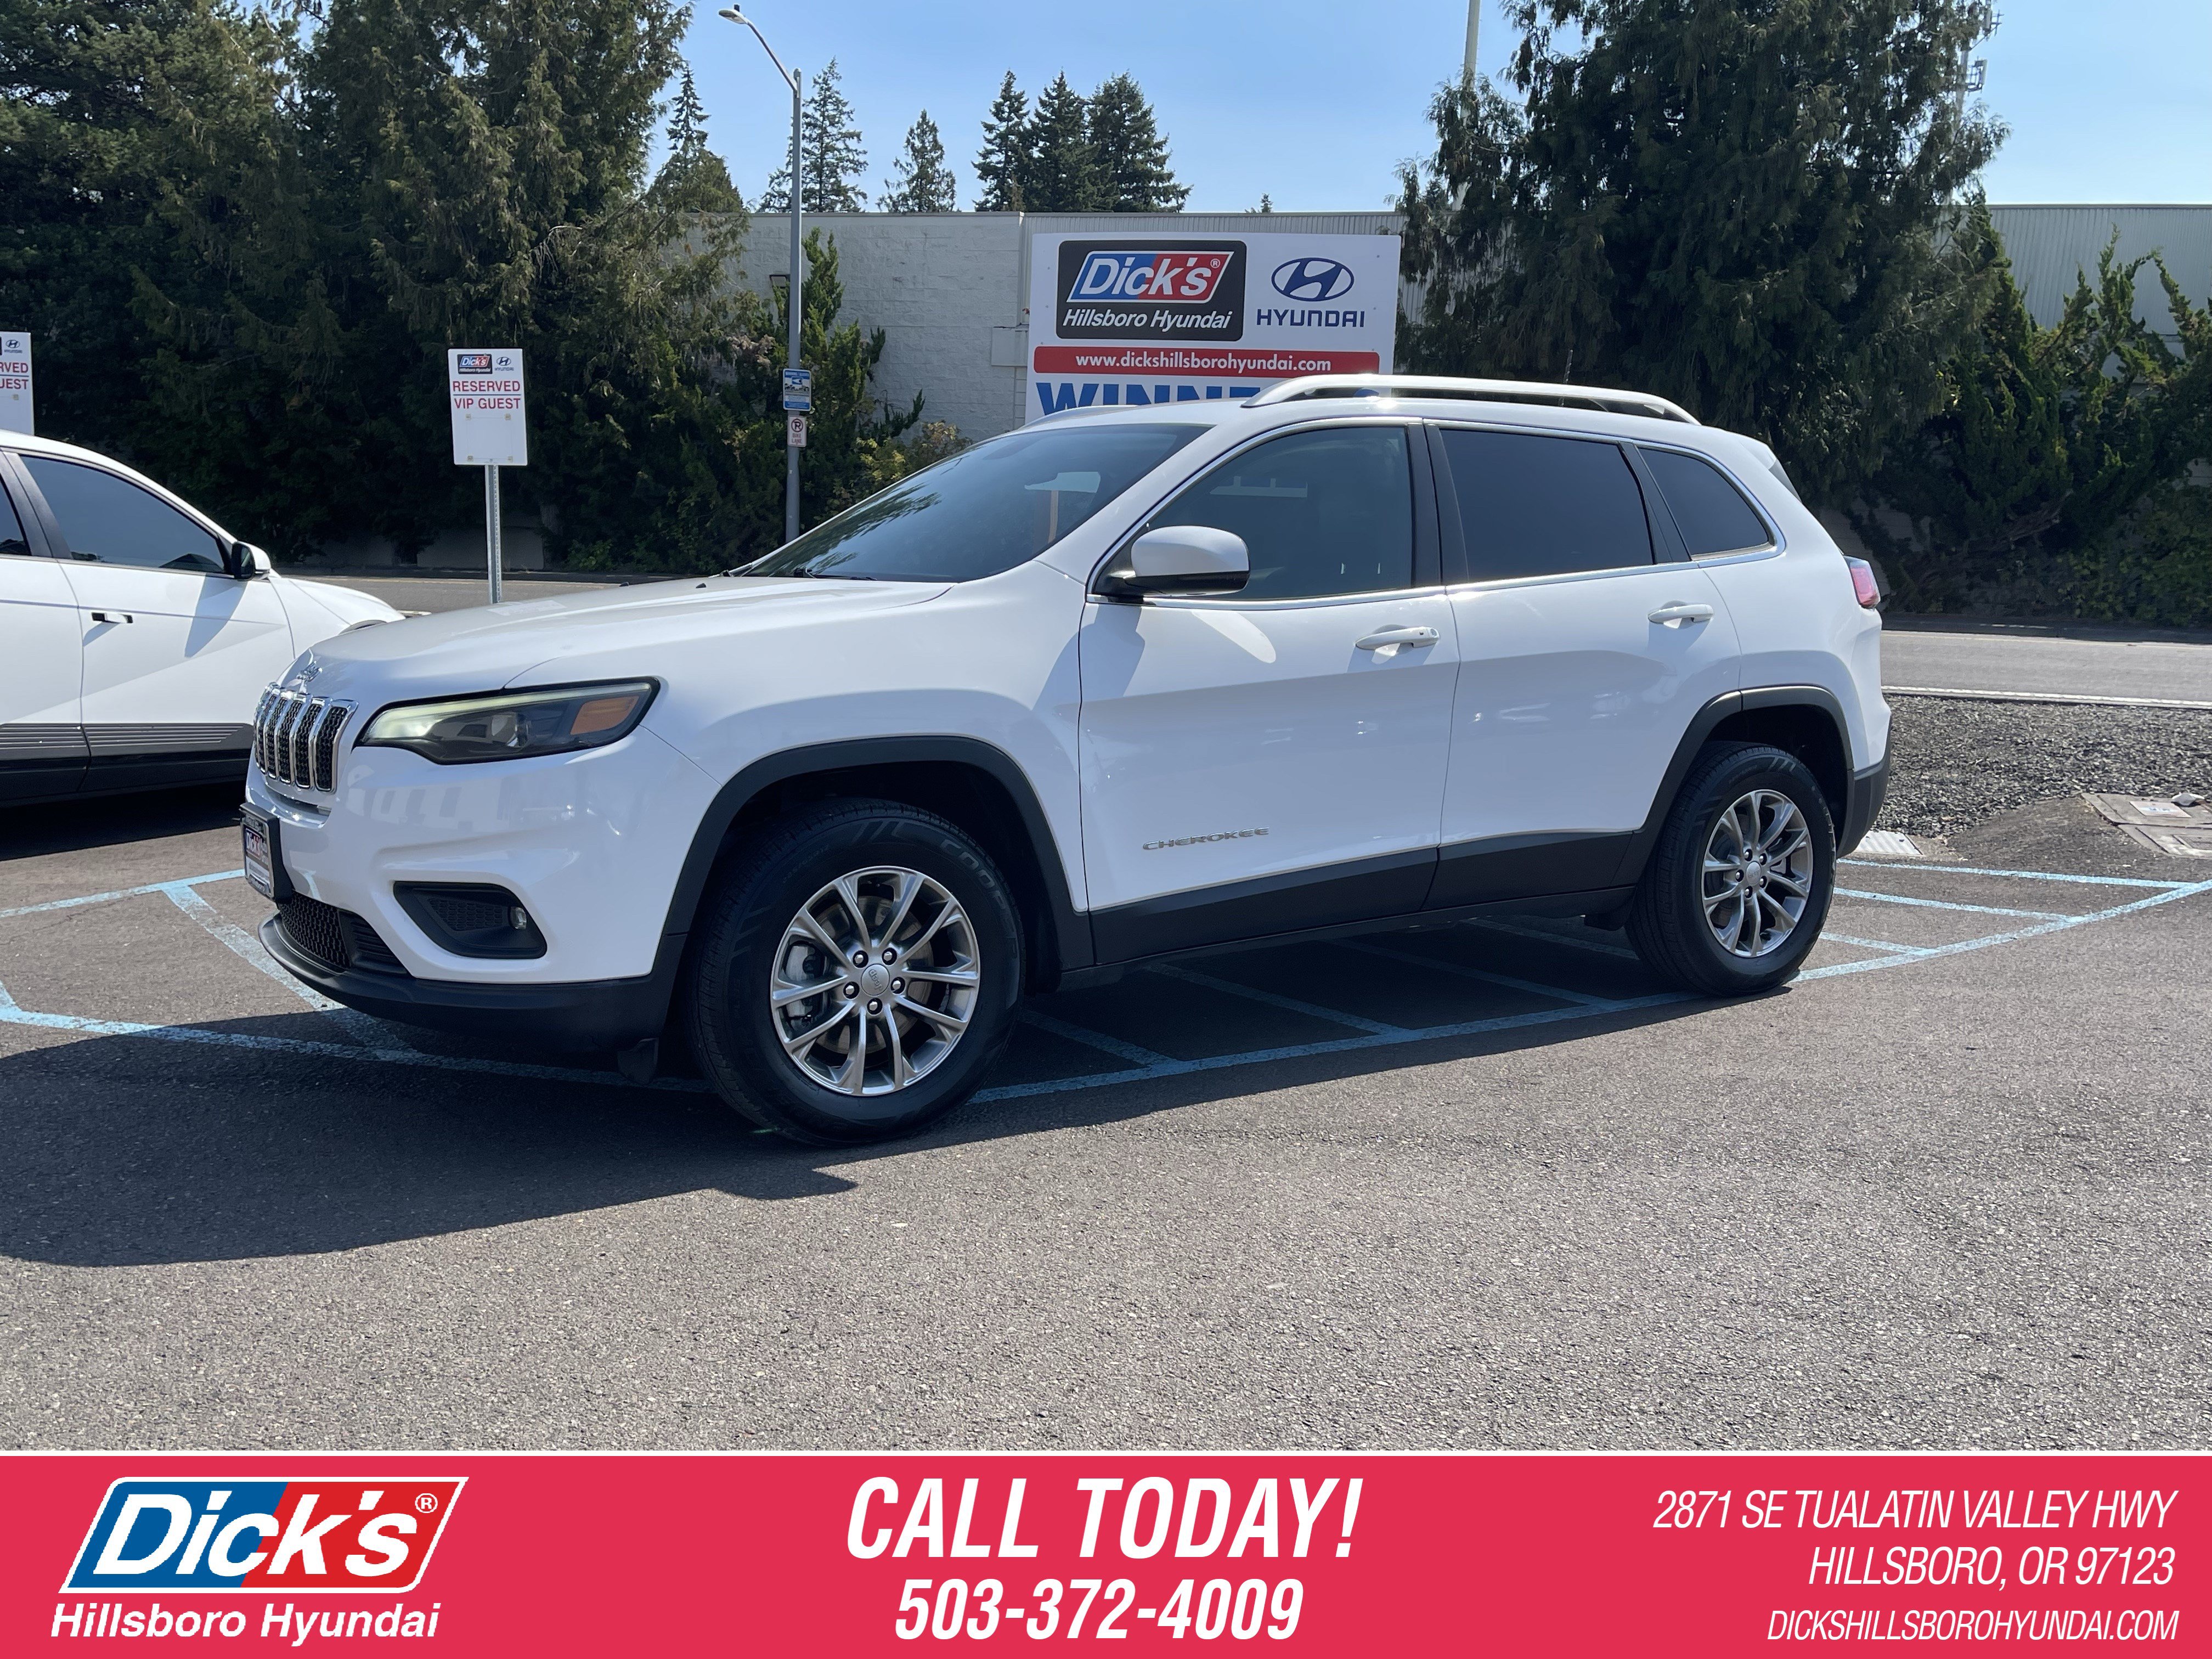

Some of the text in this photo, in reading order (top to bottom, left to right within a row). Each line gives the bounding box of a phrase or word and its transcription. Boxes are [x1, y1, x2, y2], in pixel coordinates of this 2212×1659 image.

[1079, 257, 1212, 296] Dick's
[1062, 308, 1233, 332] Hillsboro Hyundai
[1256, 308, 1365, 328] HYUNDAI
[461, 356, 487, 366] Dick's
[1075, 351, 1331, 374] www.dickshillsborohyundai.com
[453, 381, 520, 392] RESERVED
[454, 398, 521, 409] VIP GUEST
[1143, 827, 1269, 850] CHEROKEE
